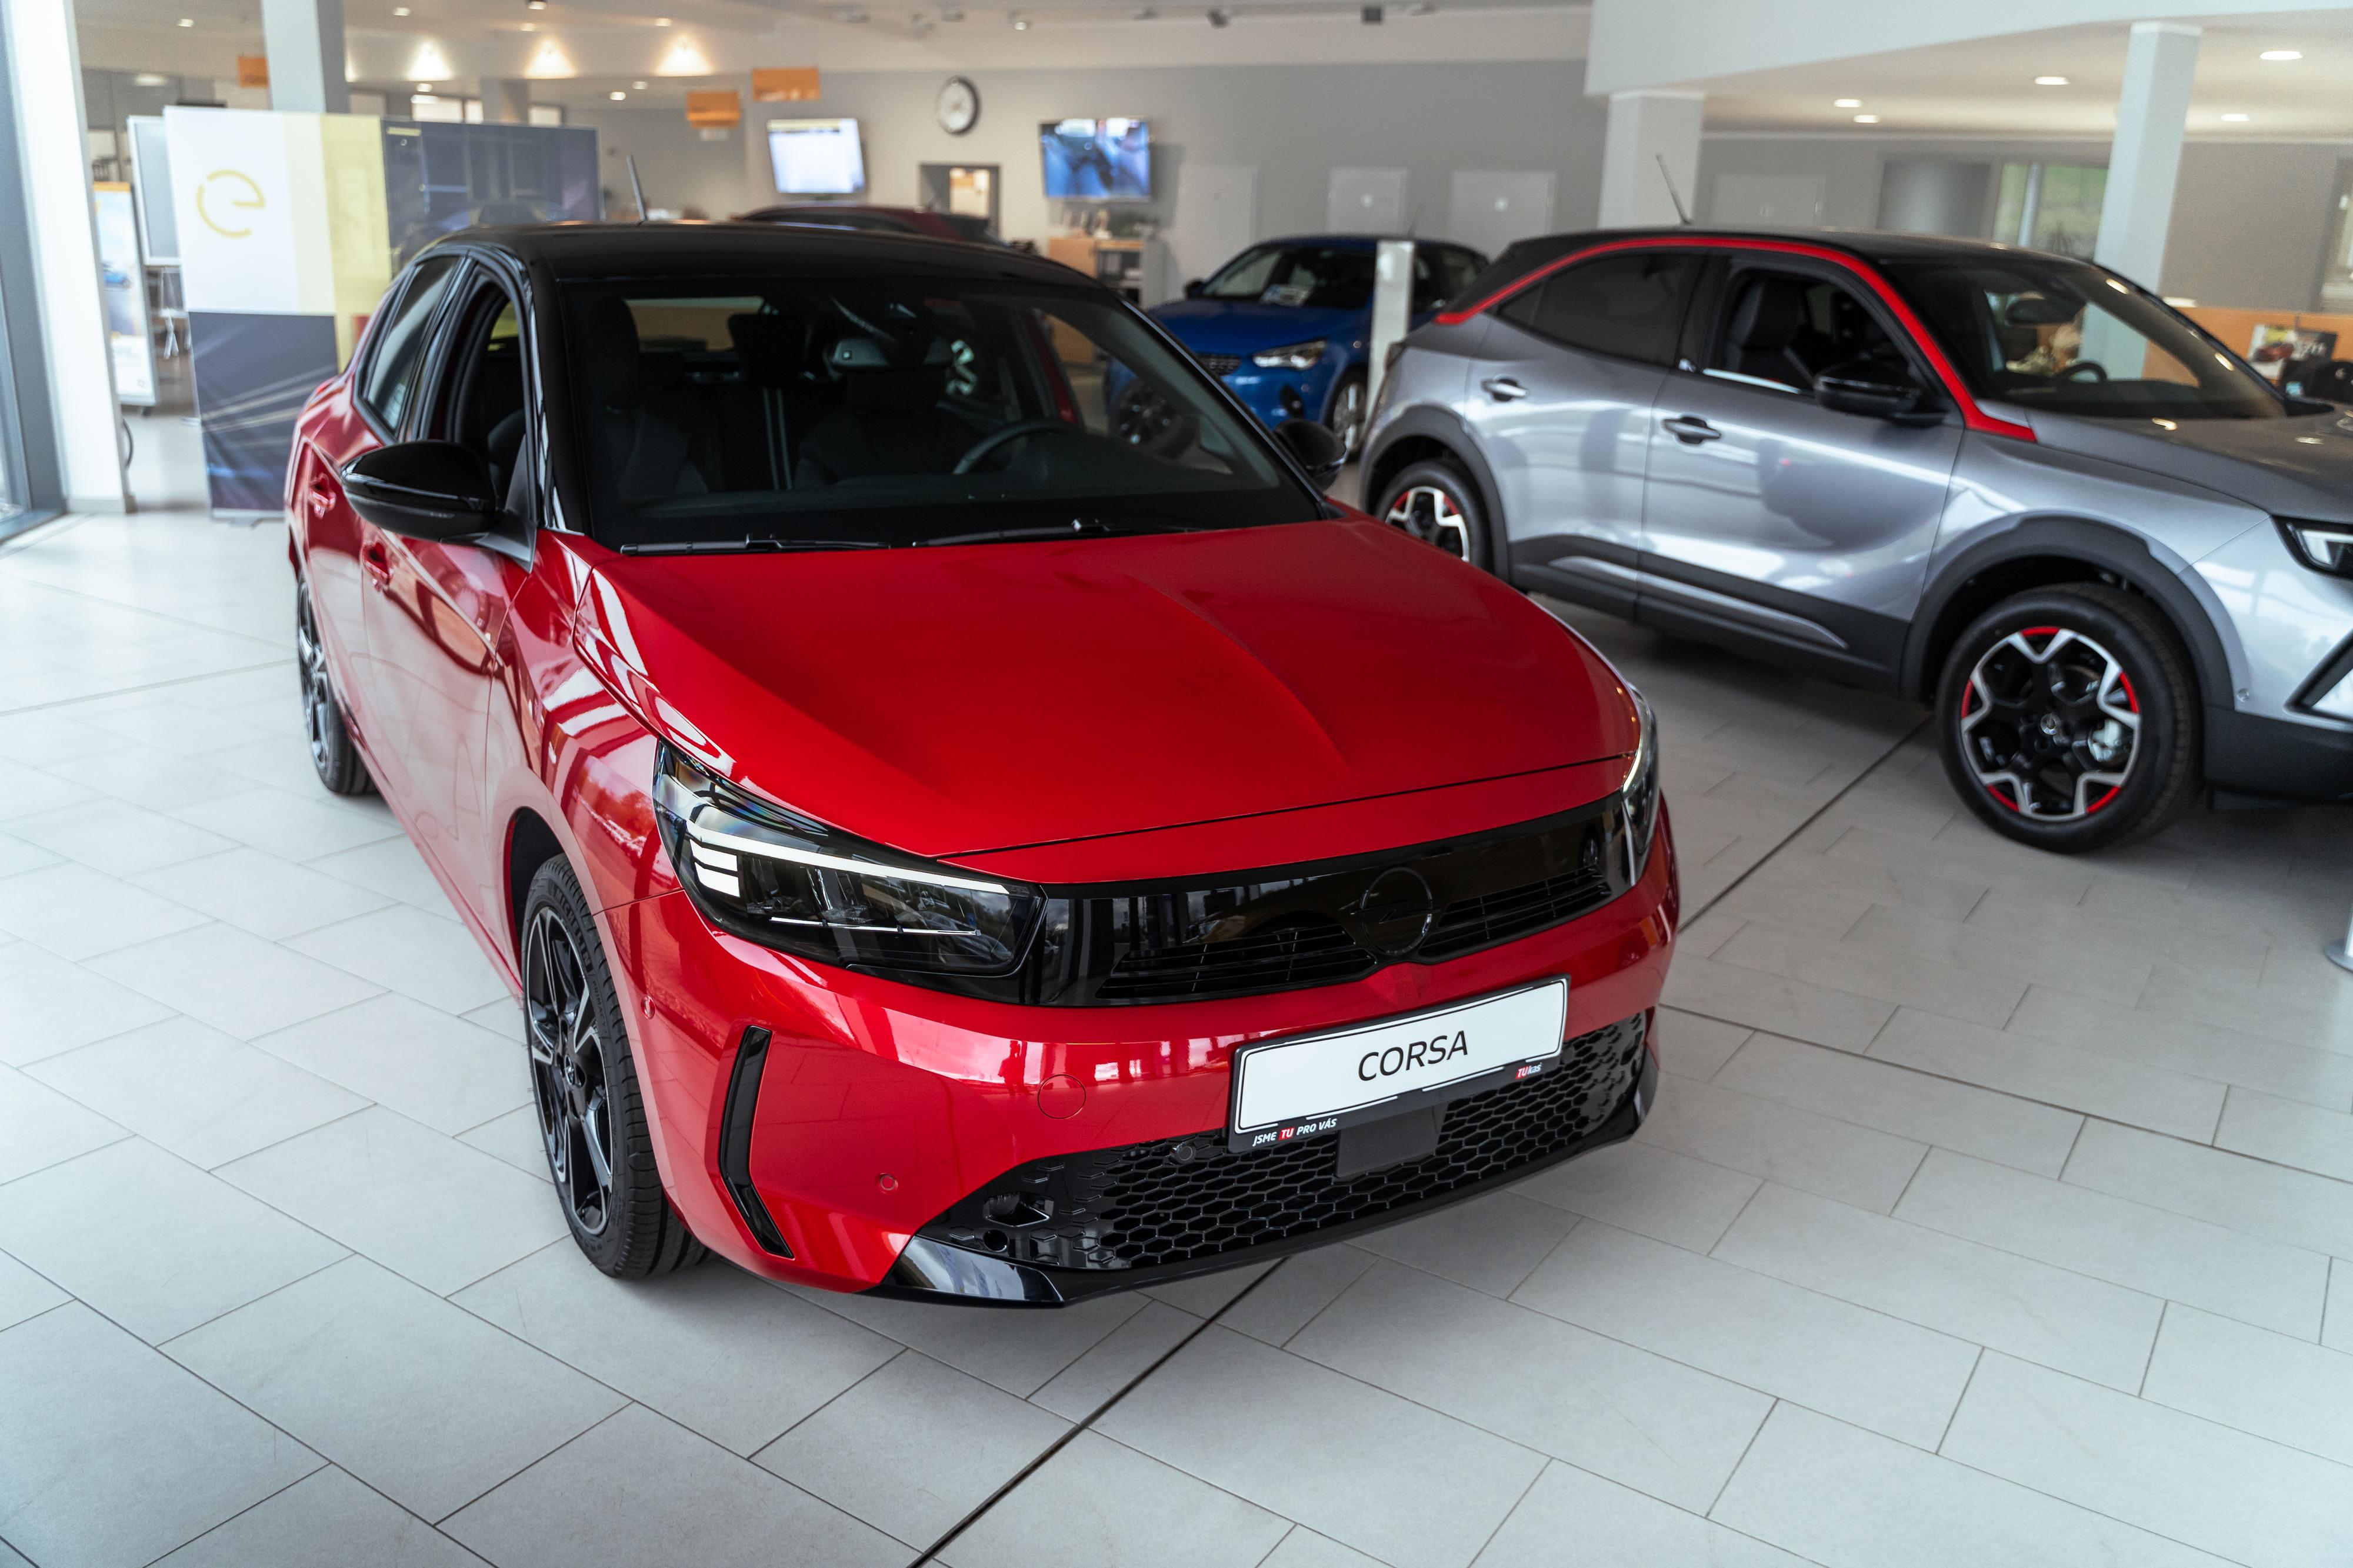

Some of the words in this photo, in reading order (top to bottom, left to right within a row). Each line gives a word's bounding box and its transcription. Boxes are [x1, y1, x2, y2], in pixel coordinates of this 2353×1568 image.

[555, 890, 592, 968] MICHELIN
[592, 980, 606, 1027] PRIMACY
[1358, 1030, 1468, 1081] CORSA
[1252, 1131, 1277, 1147] JSME
[1281, 1127, 1294, 1139] TU
[1296, 1123, 1317, 1136] PRO
[1318, 1118, 1338, 1130] VÁS
